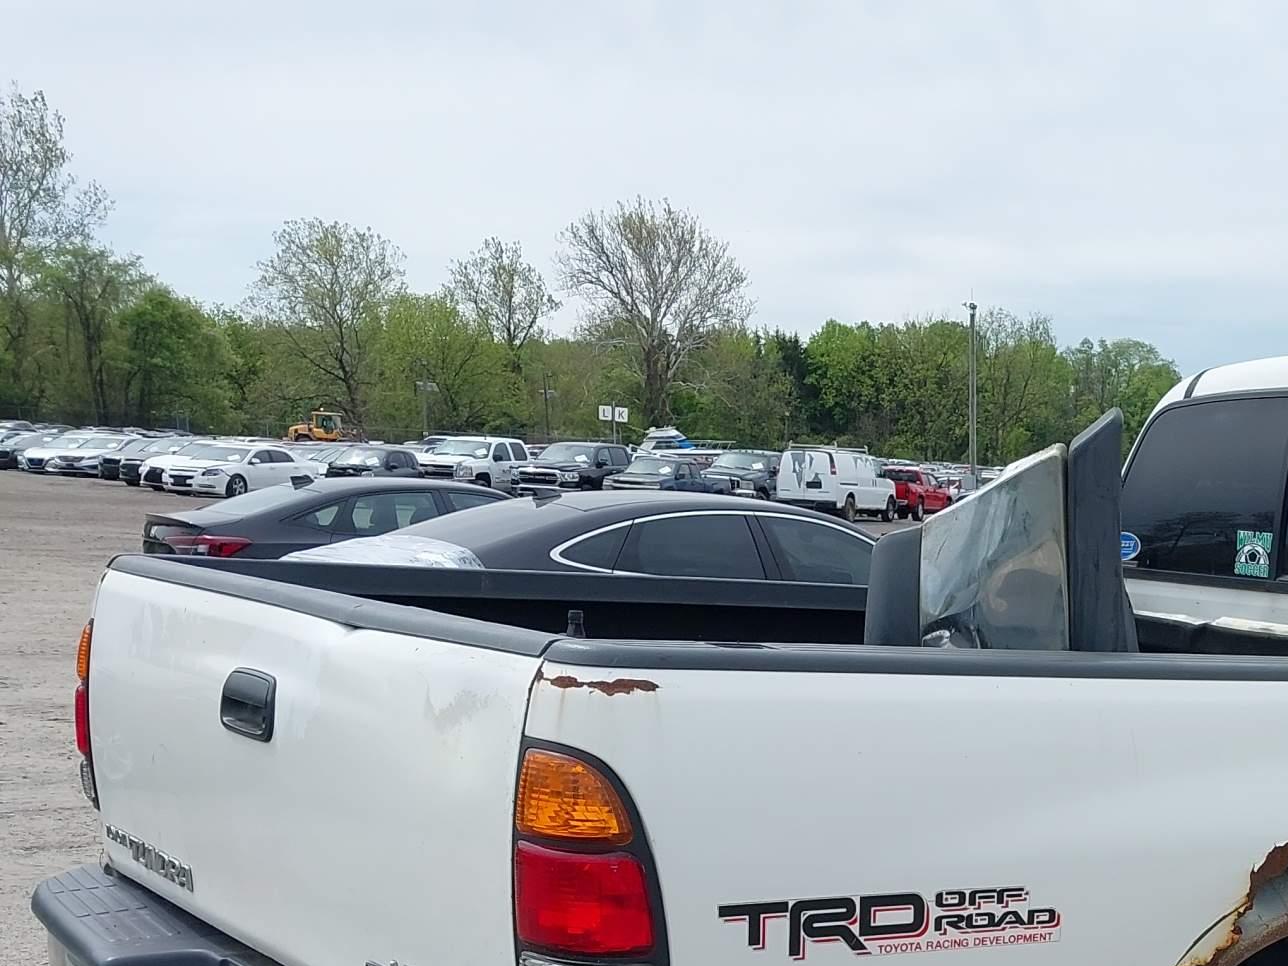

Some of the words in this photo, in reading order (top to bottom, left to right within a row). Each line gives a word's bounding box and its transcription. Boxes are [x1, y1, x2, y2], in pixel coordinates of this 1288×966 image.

[602, 408, 609, 418] L
[617, 409, 625, 420] K
[1234, 562, 1270, 578] SOCCER
[128, 835, 194, 893] TUNDRA
[935, 887, 1029, 911] OFF
[718, 893, 931, 960] TRD
[934, 907, 1061, 936] ROAD
[878, 941, 922, 954] TOYOTA
[926, 937, 969, 951] RACING
[973, 932, 1053, 947] DEVELOPMENT
